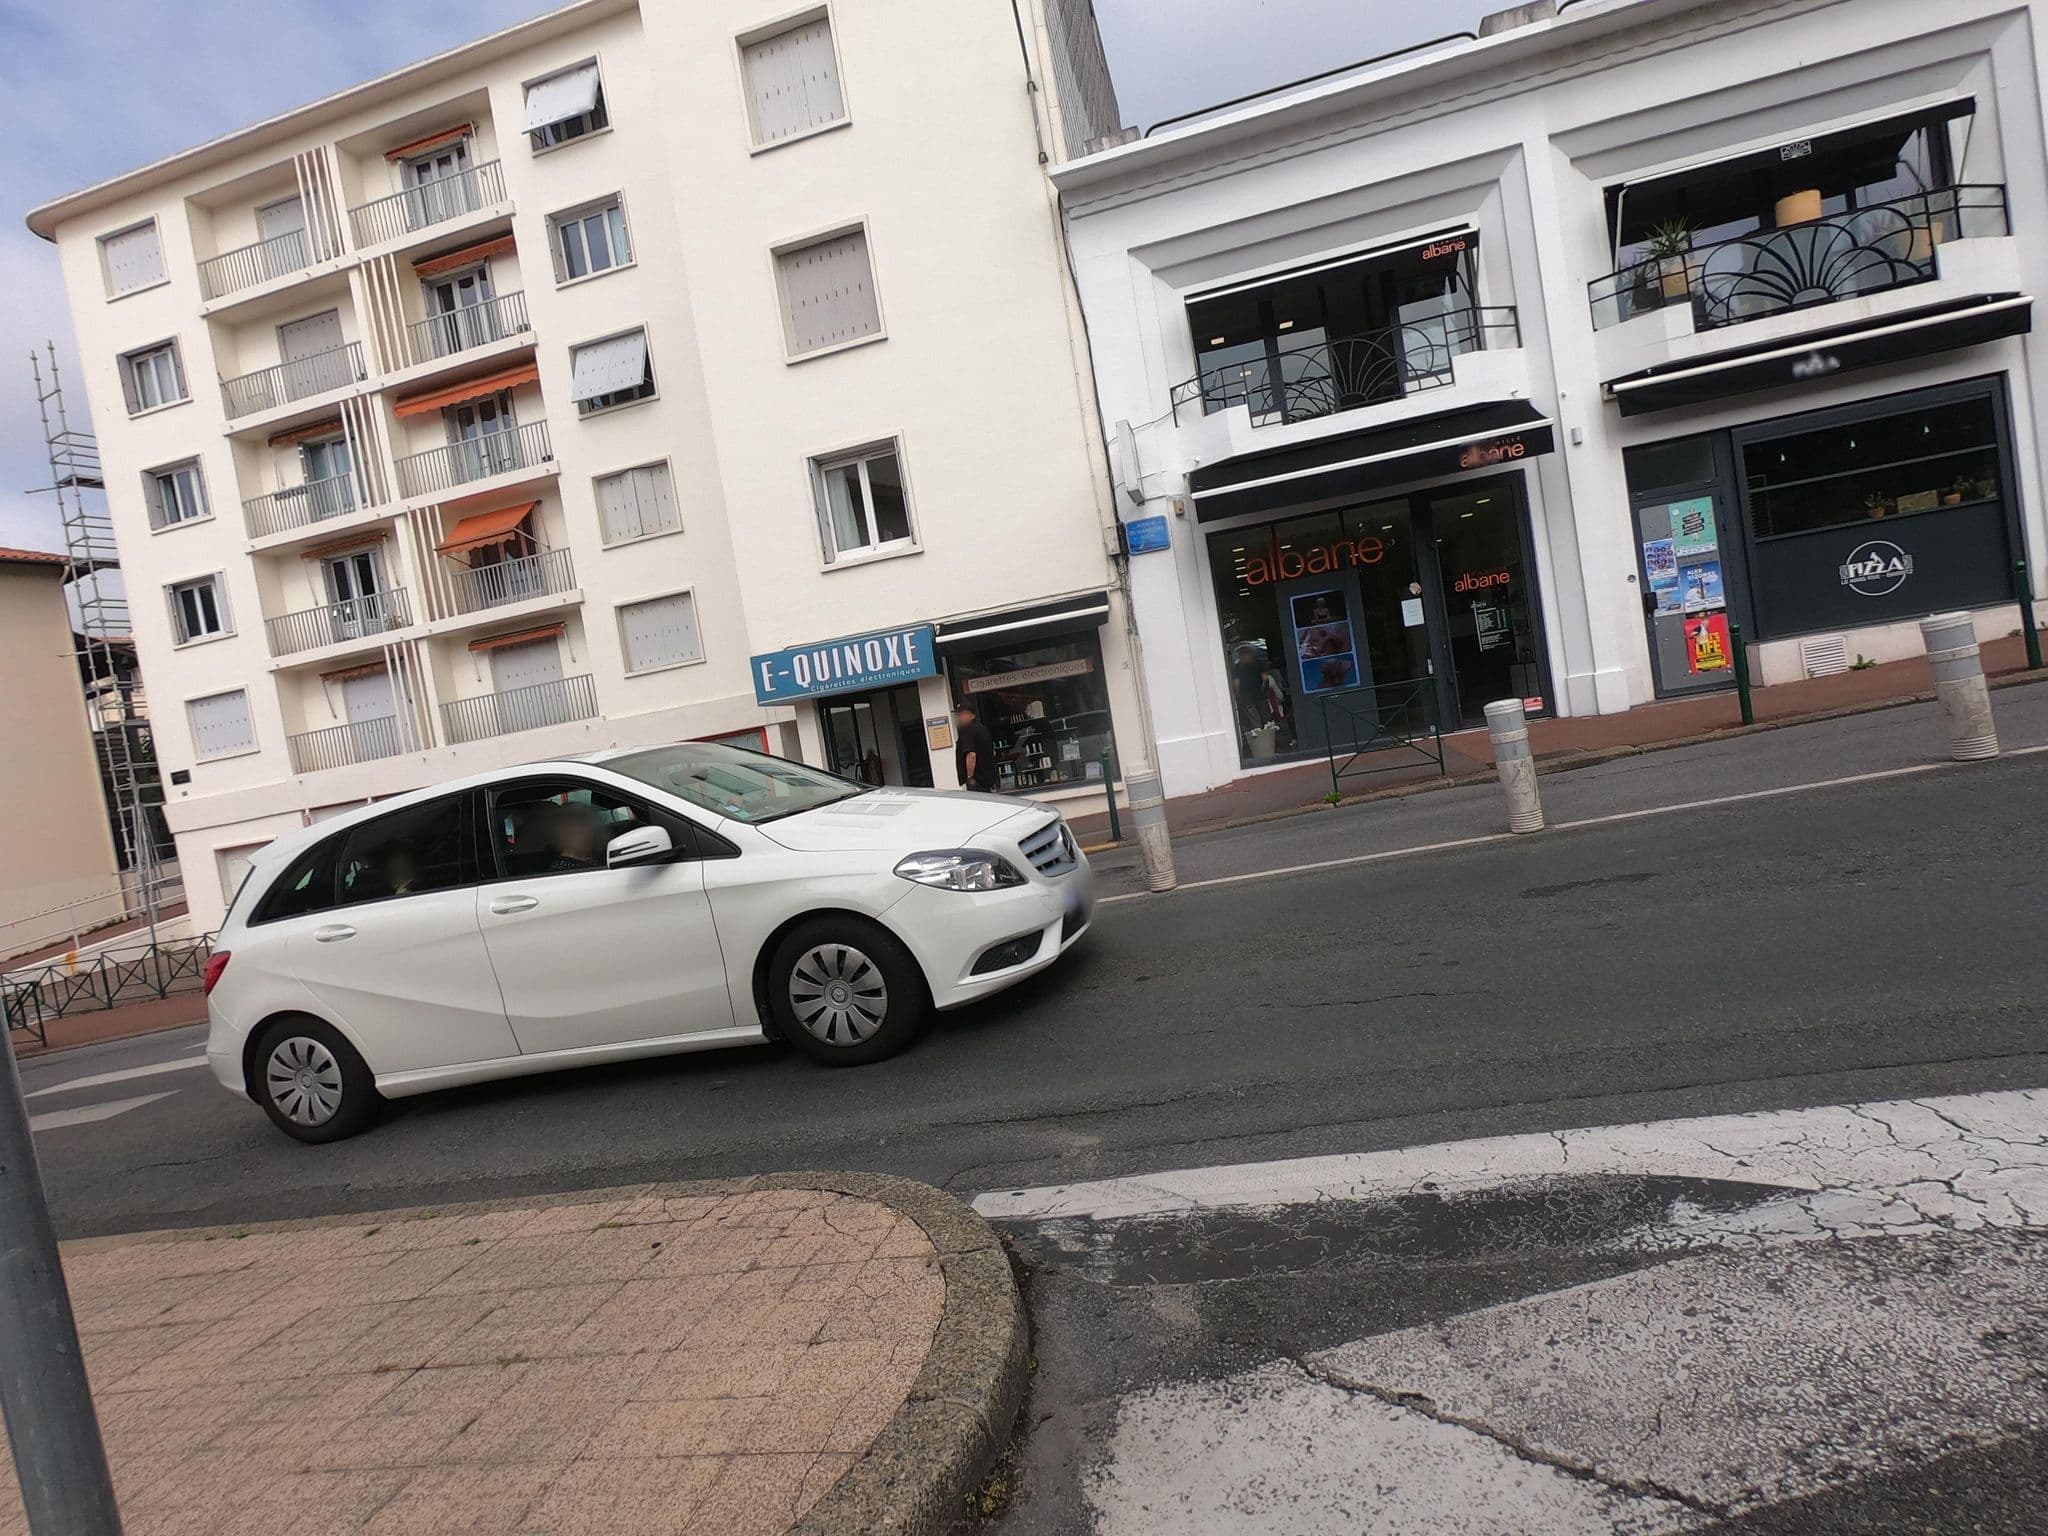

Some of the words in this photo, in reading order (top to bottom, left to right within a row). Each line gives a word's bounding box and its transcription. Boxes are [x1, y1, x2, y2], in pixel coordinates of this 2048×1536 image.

[1422, 241, 1466, 260] albane
[1461, 443, 1525, 467] aane
[1246, 537, 1384, 585] albane
[1454, 572, 1511, 592] albane
[760, 632, 919, 692] E-QUINOXE
[810, 679, 857, 692] Cigarettes
[970, 674, 1017, 689] Cigarettes
